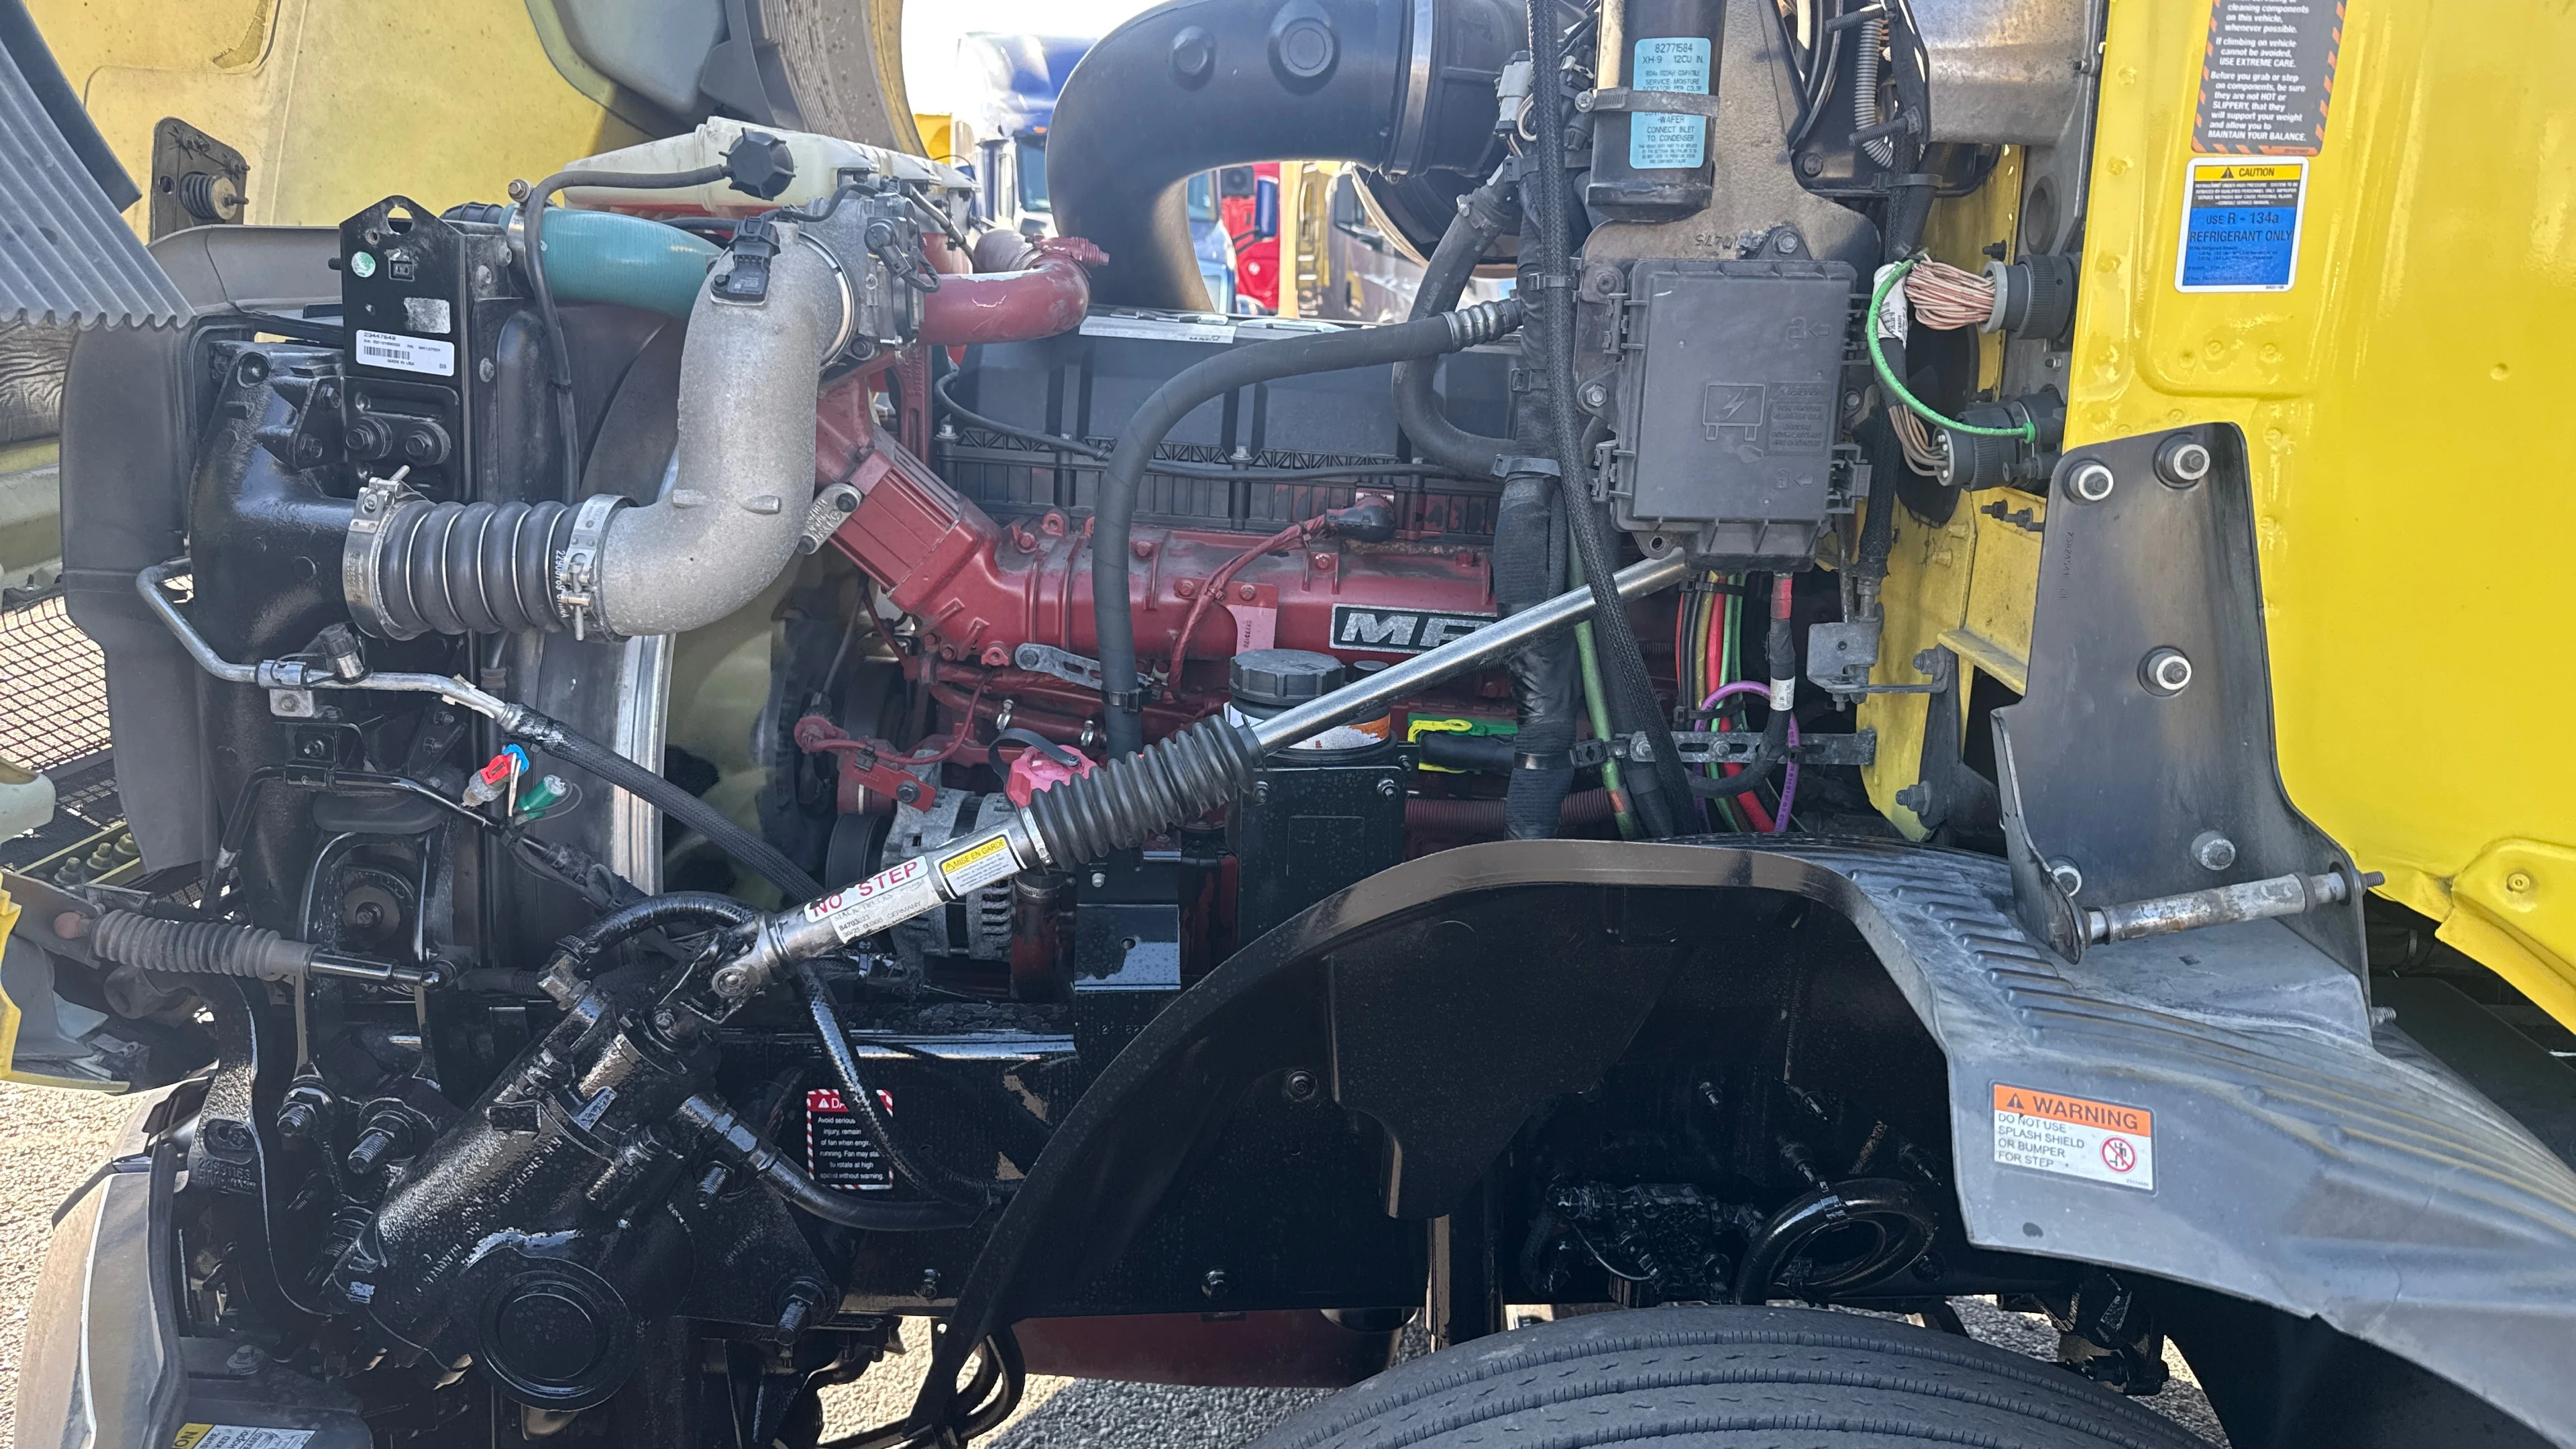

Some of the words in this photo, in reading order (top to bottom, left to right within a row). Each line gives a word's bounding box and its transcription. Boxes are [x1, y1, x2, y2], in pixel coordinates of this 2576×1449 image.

[2228, 3, 2260, 13] cleaning
[2261, 5, 2309, 14] components
[2238, 13, 2252, 21] this
[2224, 24, 2261, 32] whenever
[1655, 43, 1693, 53] 82771584
[2216, 37, 2222, 45] If
[2223, 37, 2255, 48] climbing
[2269, 40, 2297, 48] vehicle
[2220, 48, 2248, 56] cannot
[2249, 48, 2258, 56] be
[1642, 56, 1662, 64] XH-9
[1674, 55, 1692, 63] 12CU
[2219, 58, 2234, 66] USE
[2236, 58, 2271, 66] EXTREME
[2210, 70, 2235, 79] Before
[2237, 73, 2251, 81] you
[2252, 72, 2270, 83] grab
[2282, 73, 2299, 83] step
[2277, 83, 2287, 91] be
[2214, 91, 2231, 100] they
[2247, 92, 2259, 100] not
[2261, 93, 2276, 101] HOT
[2251, 102, 2267, 110] that
[2269, 103, 2286, 113] they
[2226, 112, 2256, 121] support
[2257, 113, 2275, 121] your
[2276, 113, 2303, 123] weight
[2248, 123, 2263, 131] you
[2263, 122, 2272, 130] to
[2208, 130, 2246, 139] MAINTAIN
[2247, 131, 2268, 140] YOUR
[2239, 168, 2275, 177] CAUTION
[2206, 215, 2224, 225] USE
[2250, 211, 2279, 225] 134a
[2189, 230, 2263, 243] REFRIGERANT
[2265, 230, 2294, 242] ONLY
[953, 855, 970, 868] MISE
[971, 851, 981, 859] EN
[981, 839, 1006, 855] GARDE
[812, 894, 843, 917] NO
[858, 861, 917, 896] STEP
[835, 906, 859, 922] MACK
[2033, 1095, 2138, 1130] WARNING
[1998, 1113, 2015, 1124] DO
[2019, 1116, 2040, 1129] NOT
[2043, 1120, 2067, 1133] USE
[1998, 1125, 2041, 1141] SPLASH
[2044, 1133, 2084, 1148] SHIELD
[1998, 1138, 2015, 1149] OR
[2018, 1140, 2065, 1158] BUMPER
[1998, 1150, 2022, 1163] FOR
[2025, 1155, 2054, 1168] STEP
[861, 1161, 874, 1169] high
